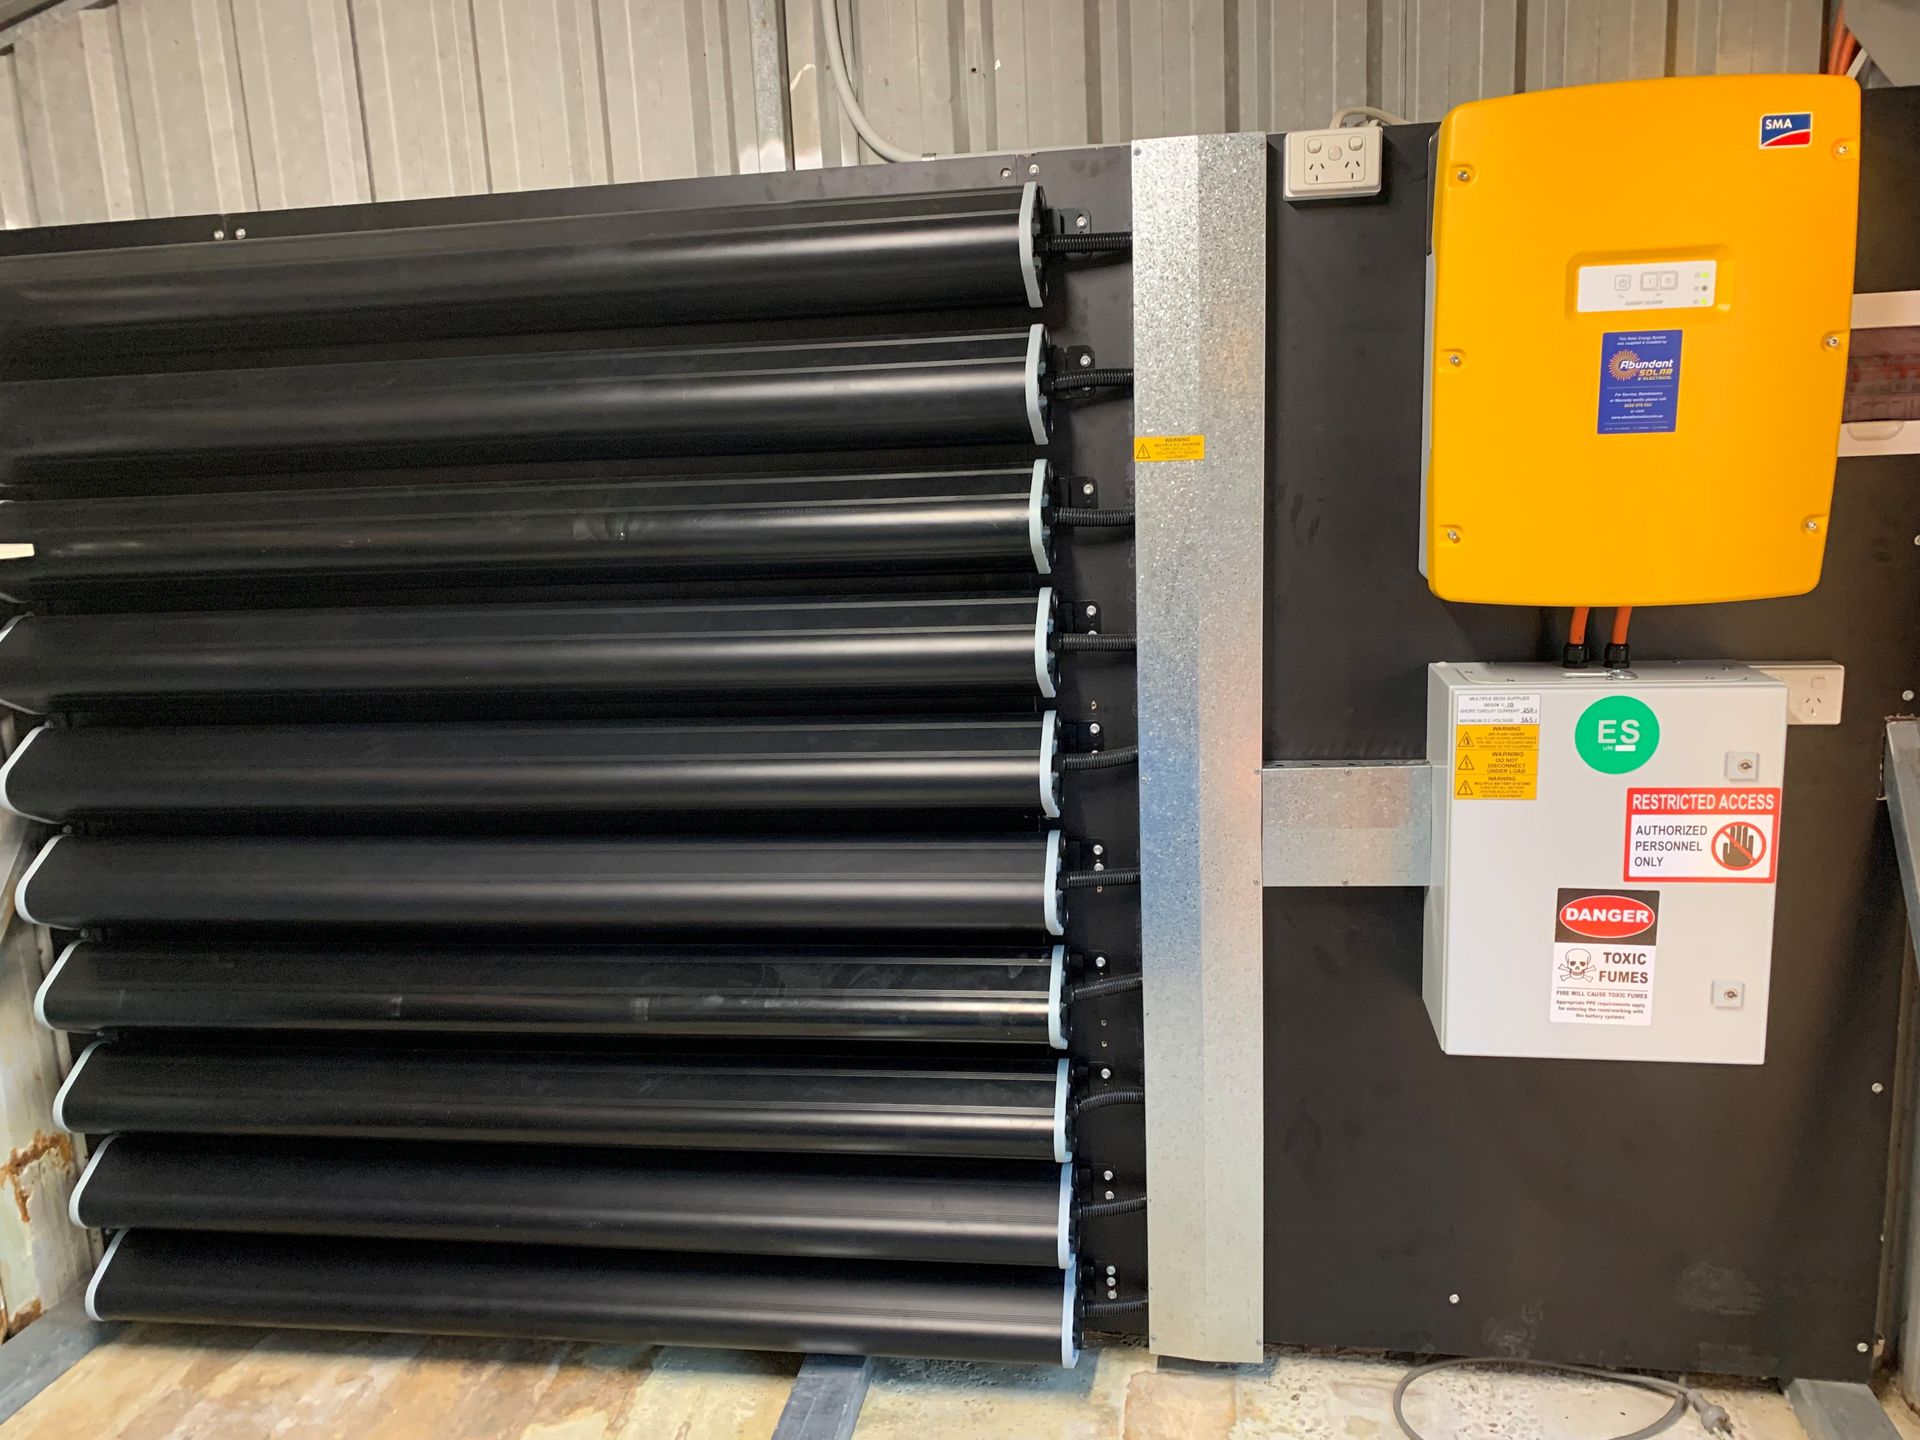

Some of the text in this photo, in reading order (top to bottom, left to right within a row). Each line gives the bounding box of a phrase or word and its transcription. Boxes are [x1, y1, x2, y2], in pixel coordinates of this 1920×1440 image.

[1765, 118, 1792, 130] SMA
[1620, 358, 1674, 370] Abundant
[1639, 368, 1673, 377] SOLAR
[1597, 719, 1640, 744] ES
[1632, 794, 1775, 810] RESTRICTED ACCESS
[1635, 825, 1708, 836] AUTHORIZED
[1635, 841, 1703, 852] PERSONNEL
[1634, 857, 1664, 867] ONLY
[1565, 907, 1649, 924] DANGER
[1603, 952, 1647, 965] TOXIC
[1598, 970, 1648, 984] FUMES
